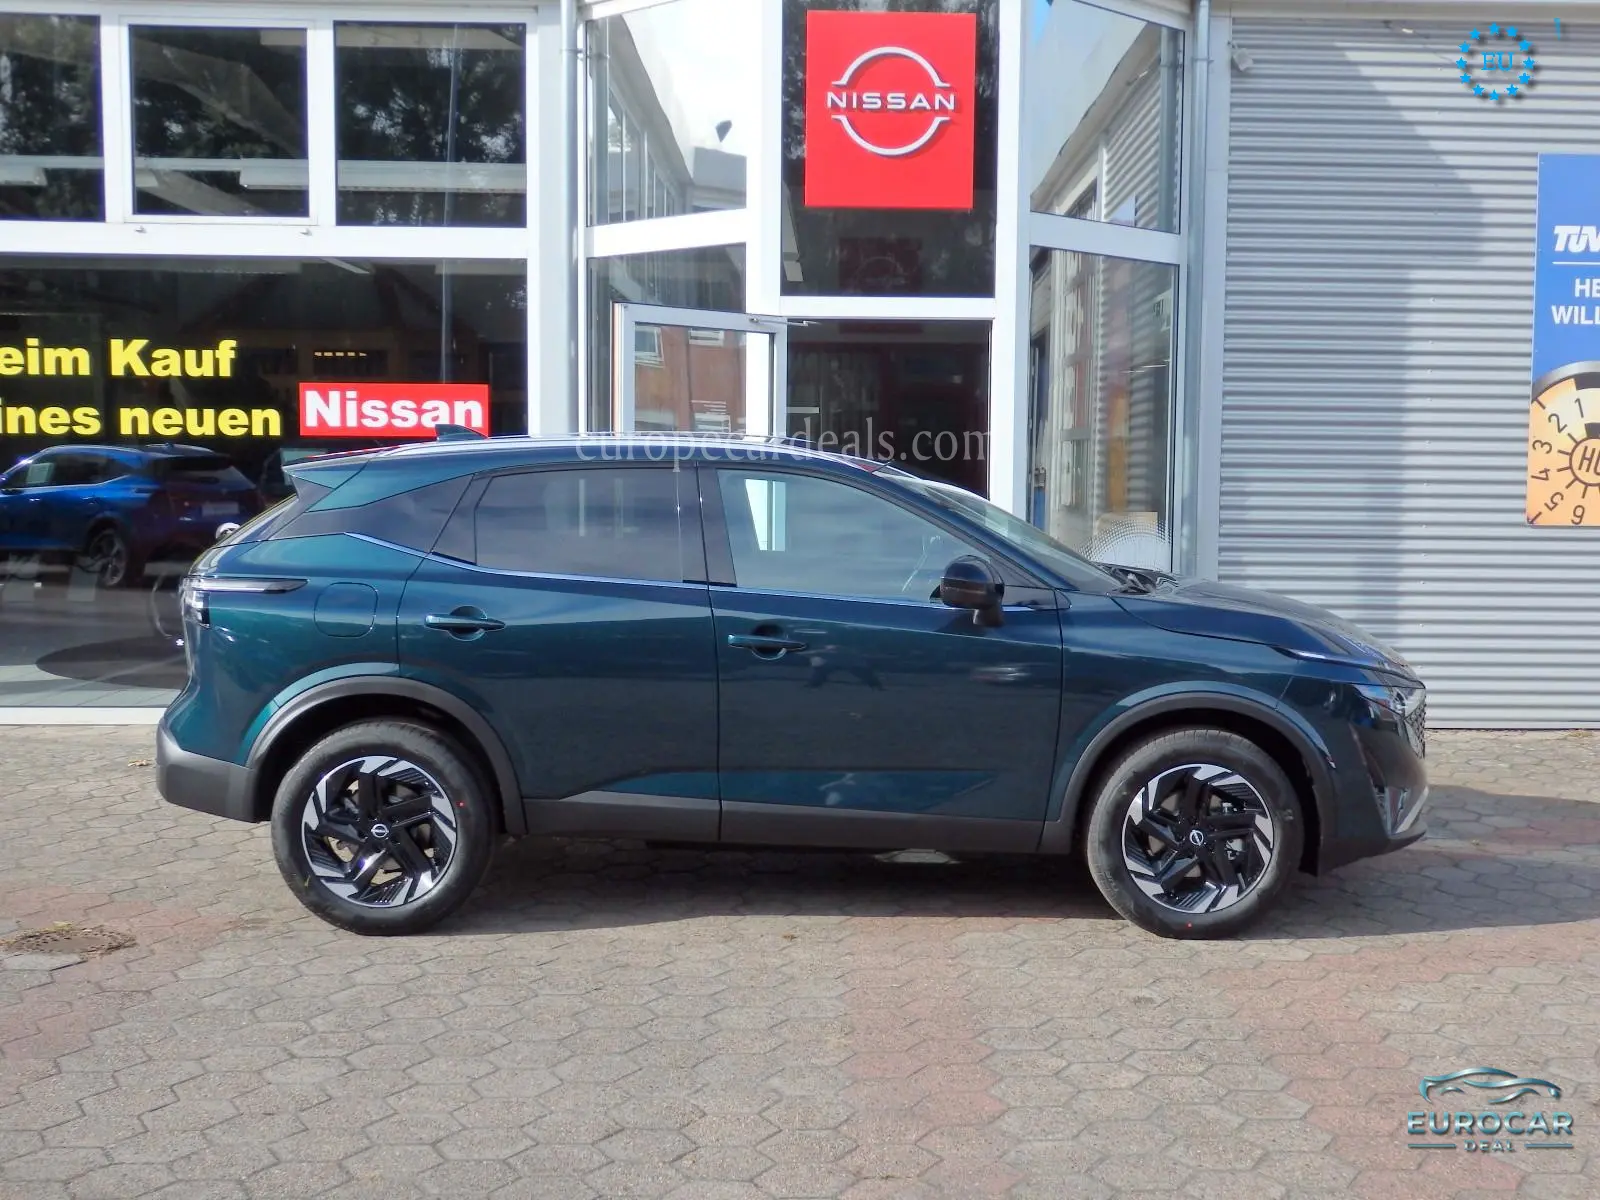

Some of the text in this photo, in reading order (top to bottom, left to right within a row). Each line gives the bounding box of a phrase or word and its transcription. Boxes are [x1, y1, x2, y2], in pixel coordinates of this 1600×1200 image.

[827, 91, 955, 110] NISSAN
[0, 338, 237, 377] eim Kauf
[0, 398, 281, 436] nes neuen
[305, 390, 483, 428] Nissan
[1548, 413, 1568, 434] 2
[1532, 439, 1553, 455] 3
[1530, 467, 1550, 481] 4
